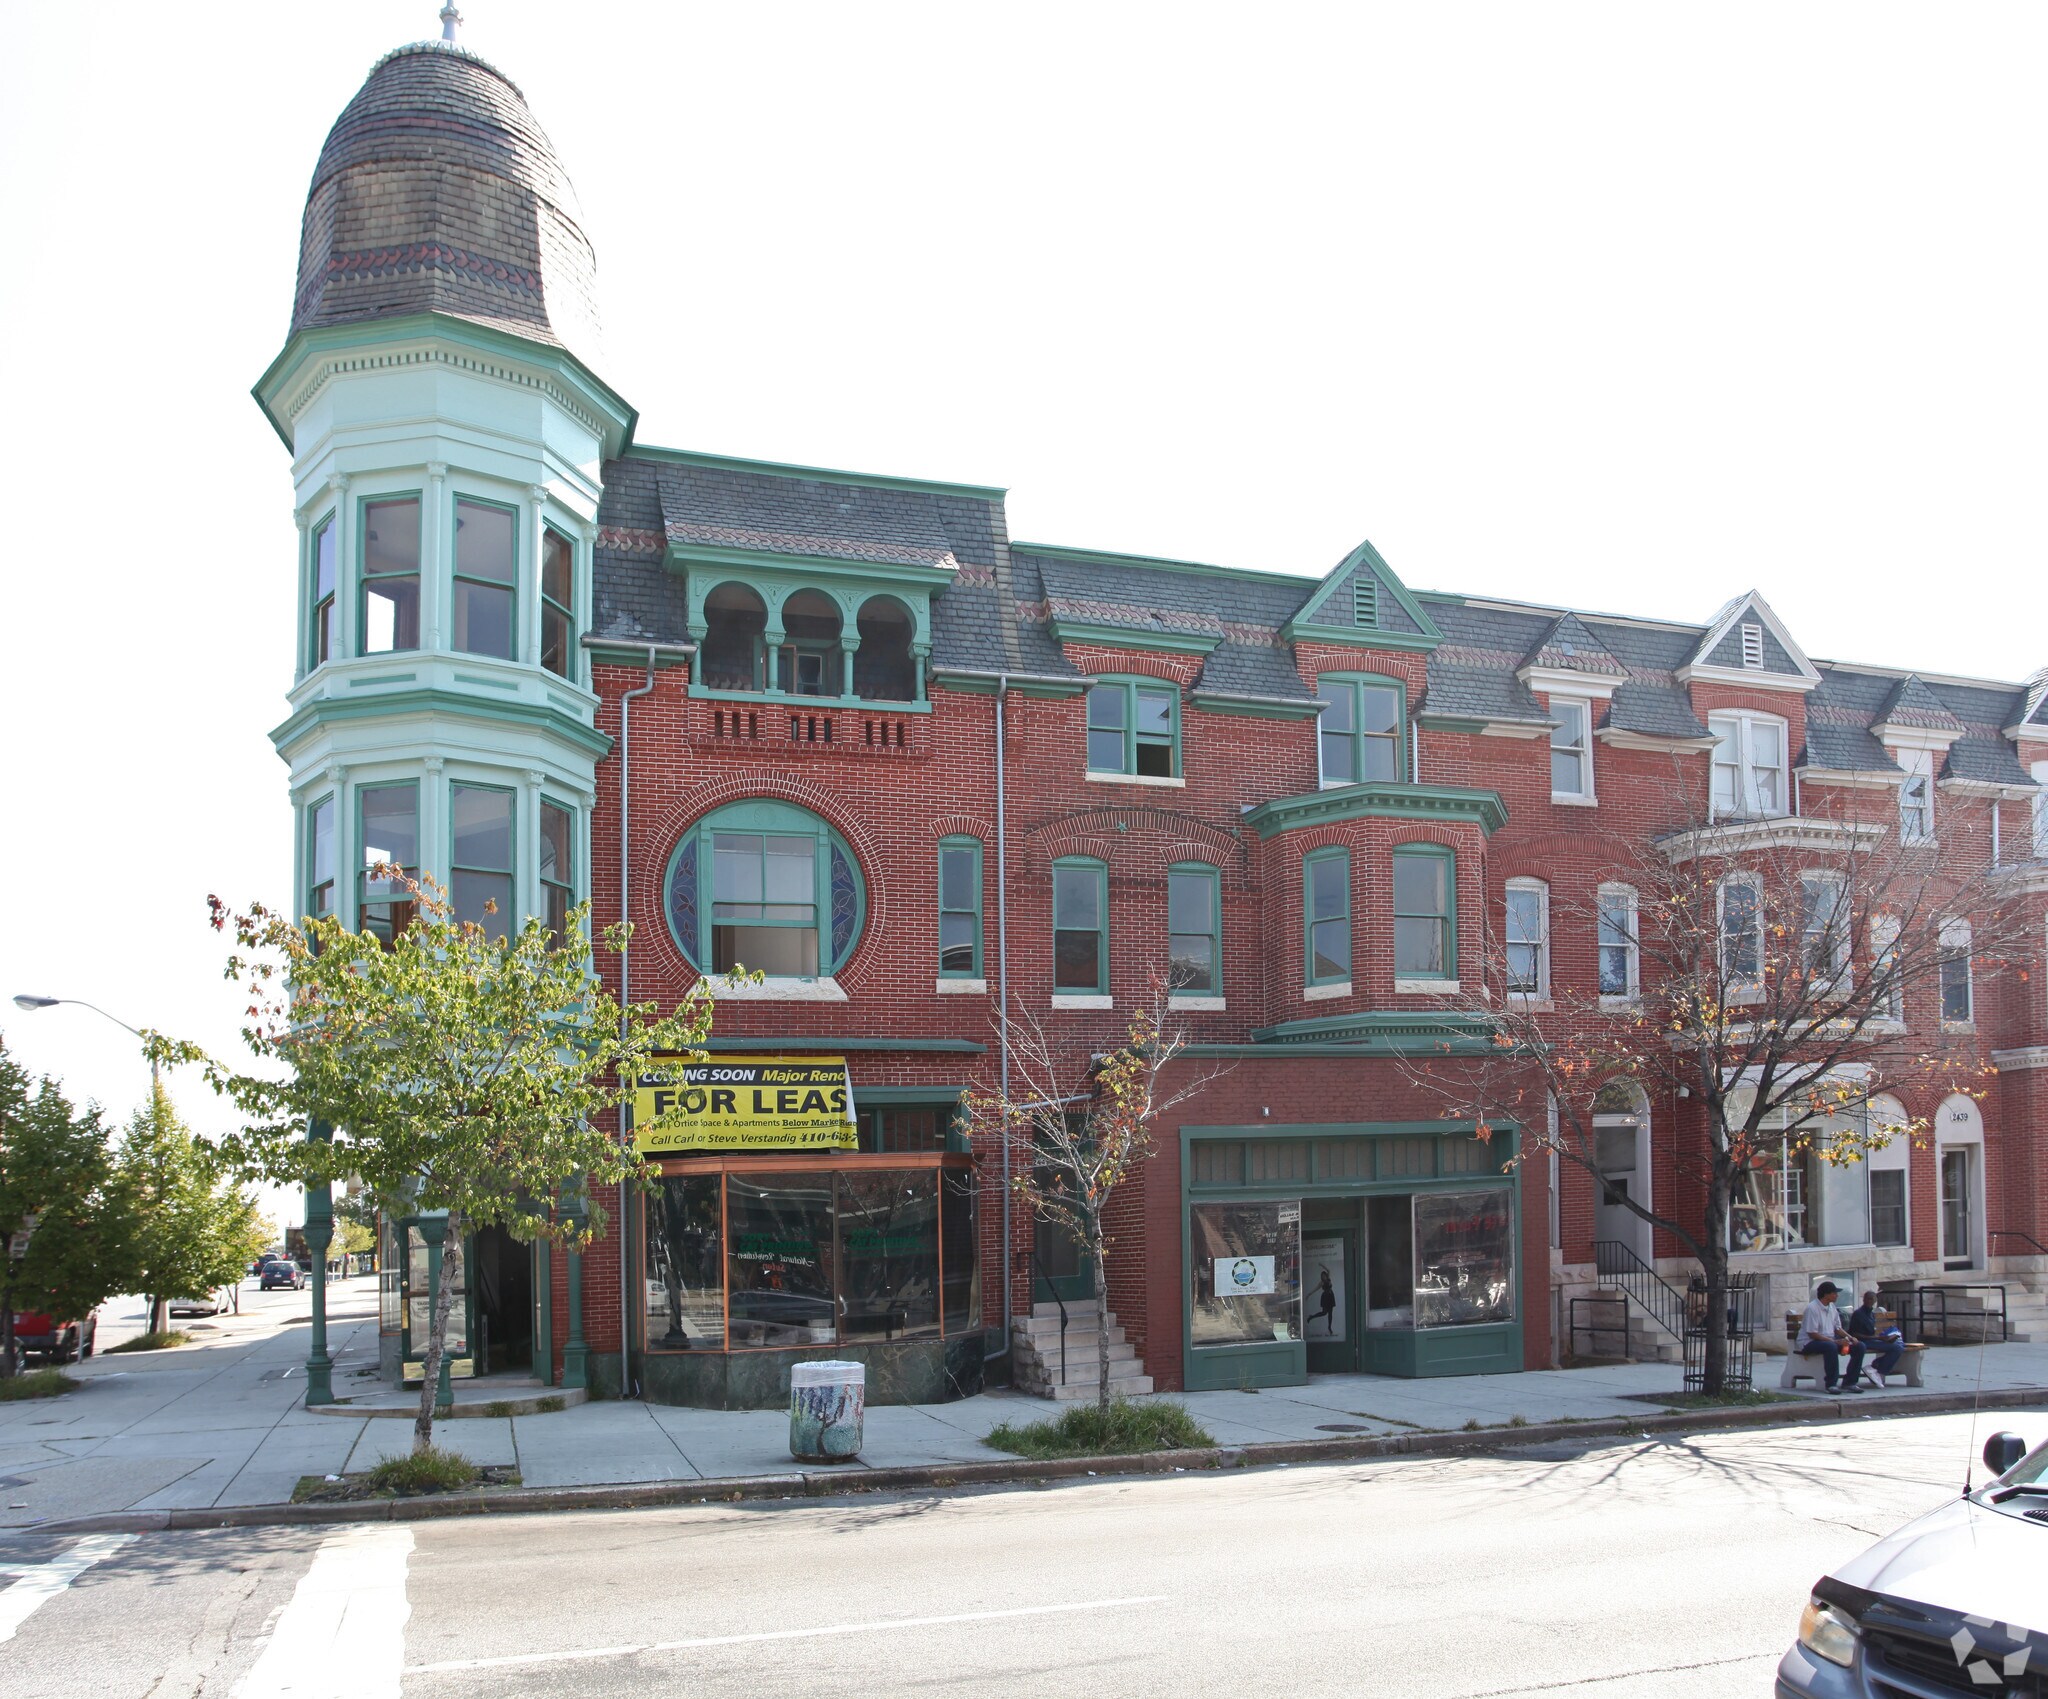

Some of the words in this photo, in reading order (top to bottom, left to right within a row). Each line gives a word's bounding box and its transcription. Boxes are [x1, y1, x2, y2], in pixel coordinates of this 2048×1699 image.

[642, 1069, 708, 1082] CONG
[710, 1069, 756, 1081] SOON
[762, 1069, 808, 1084] Major
[654, 1088, 738, 1116] FOR
[752, 1088, 847, 1114] LEAS
[723, 1119, 730, 1127] &
[732, 1118, 780, 1128] Apartments
[782, 1118, 809, 1127] Below
[811, 1118, 839, 1127] Marke
[1952, 1112, 1969, 1122] 2439
[651, 1136, 671, 1145] Call
[673, 1134, 695, 1144] Carl
[708, 1134, 737, 1143] Steve
[741, 1133, 797, 1145] Verstandig
